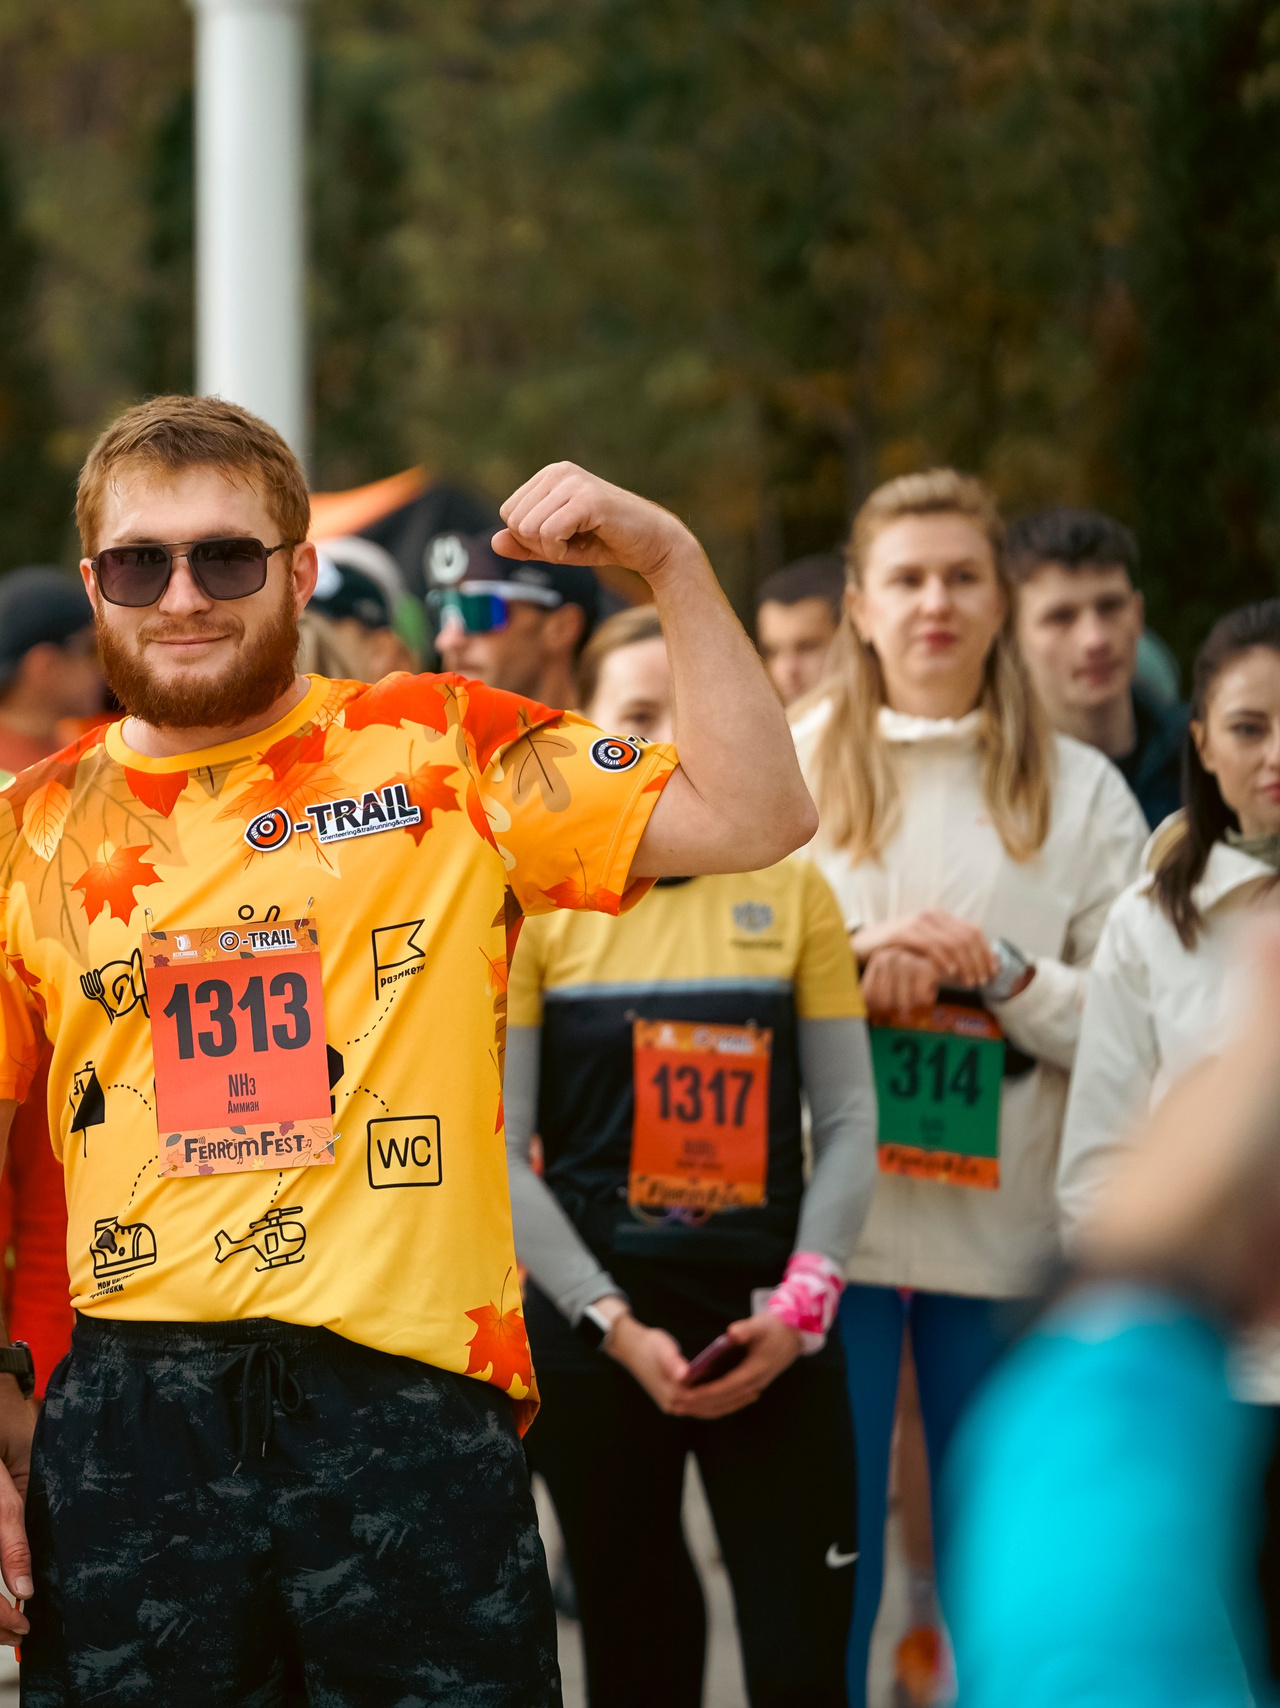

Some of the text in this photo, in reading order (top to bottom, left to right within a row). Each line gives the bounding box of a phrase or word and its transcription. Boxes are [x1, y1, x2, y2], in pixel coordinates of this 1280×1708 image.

[163, 972, 312, 1060] 1313
[228, 1072, 257, 1098] NH3
[652, 1062, 755, 1129] 1317
[888, 1036, 983, 1108] 314
[227, 1100, 260, 1114] Аммиак
[377, 1135, 432, 1169] WC
